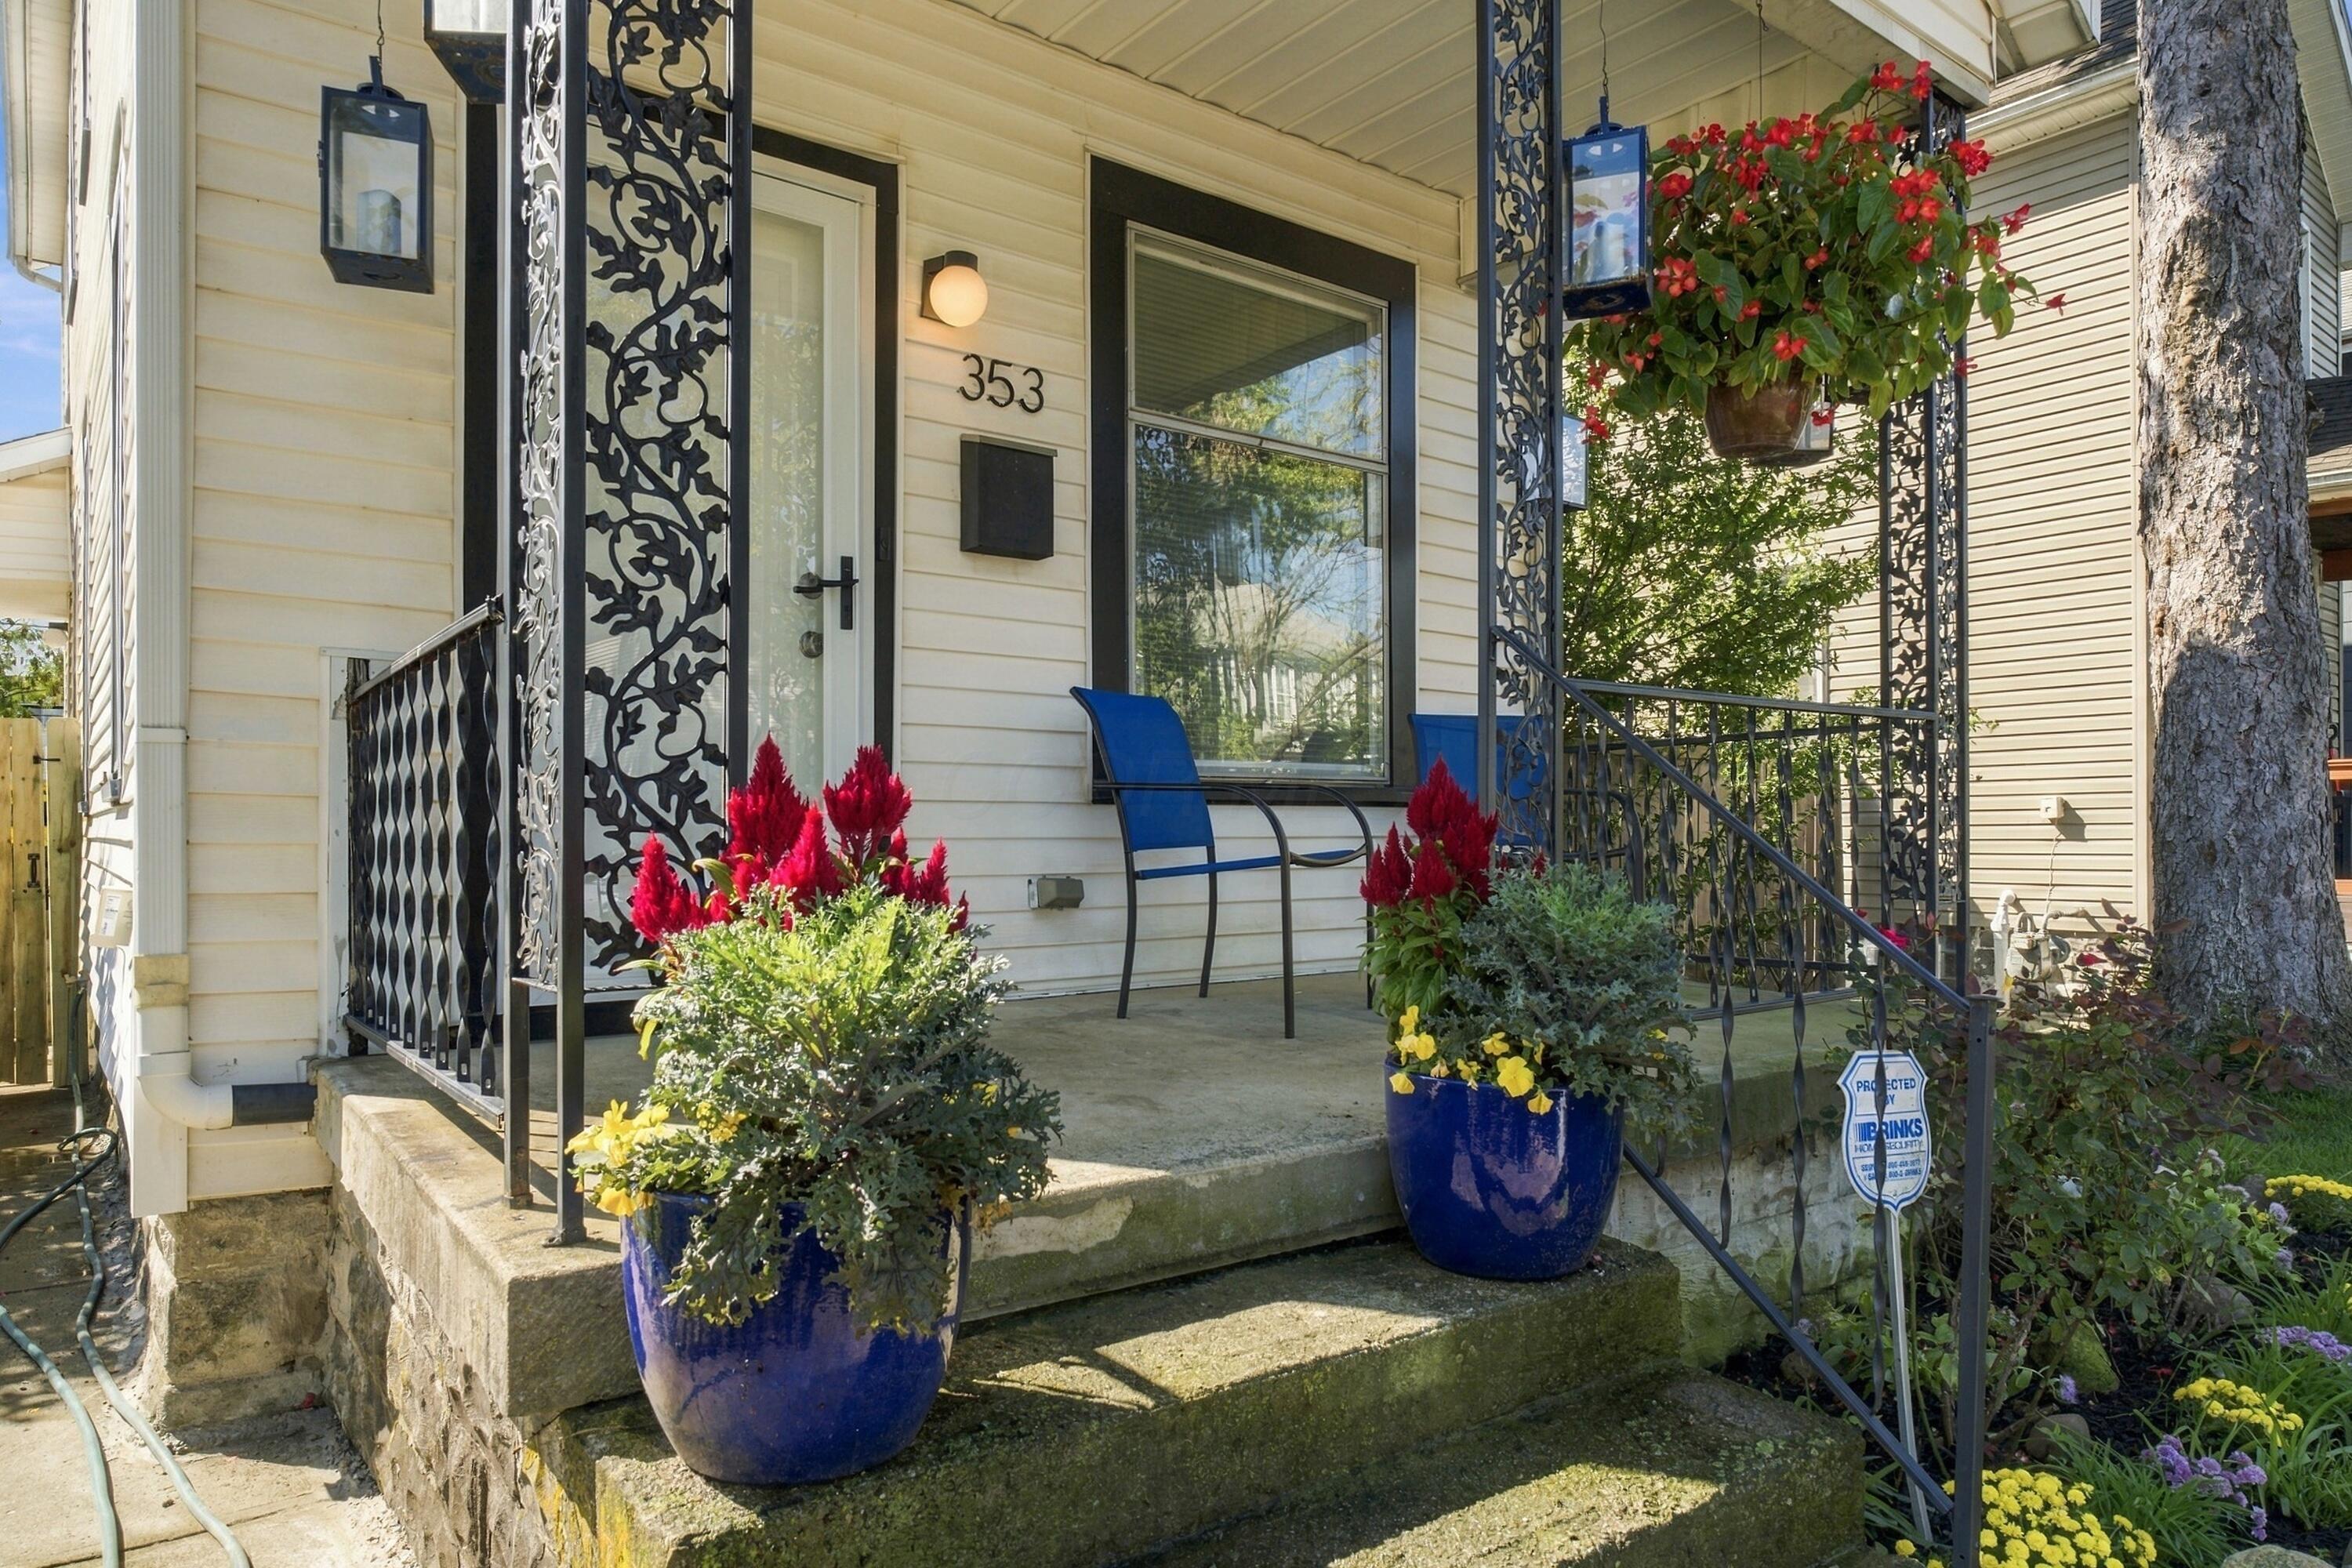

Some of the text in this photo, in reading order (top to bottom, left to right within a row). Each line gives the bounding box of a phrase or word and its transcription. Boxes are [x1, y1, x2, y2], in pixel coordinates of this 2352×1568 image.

[959, 354, 1044, 413] 353
[1856, 1078, 1916, 1092] PROECTED
[1865, 1118, 1923, 1141] BRINKS
[1855, 1142, 1875, 1152] HOM
